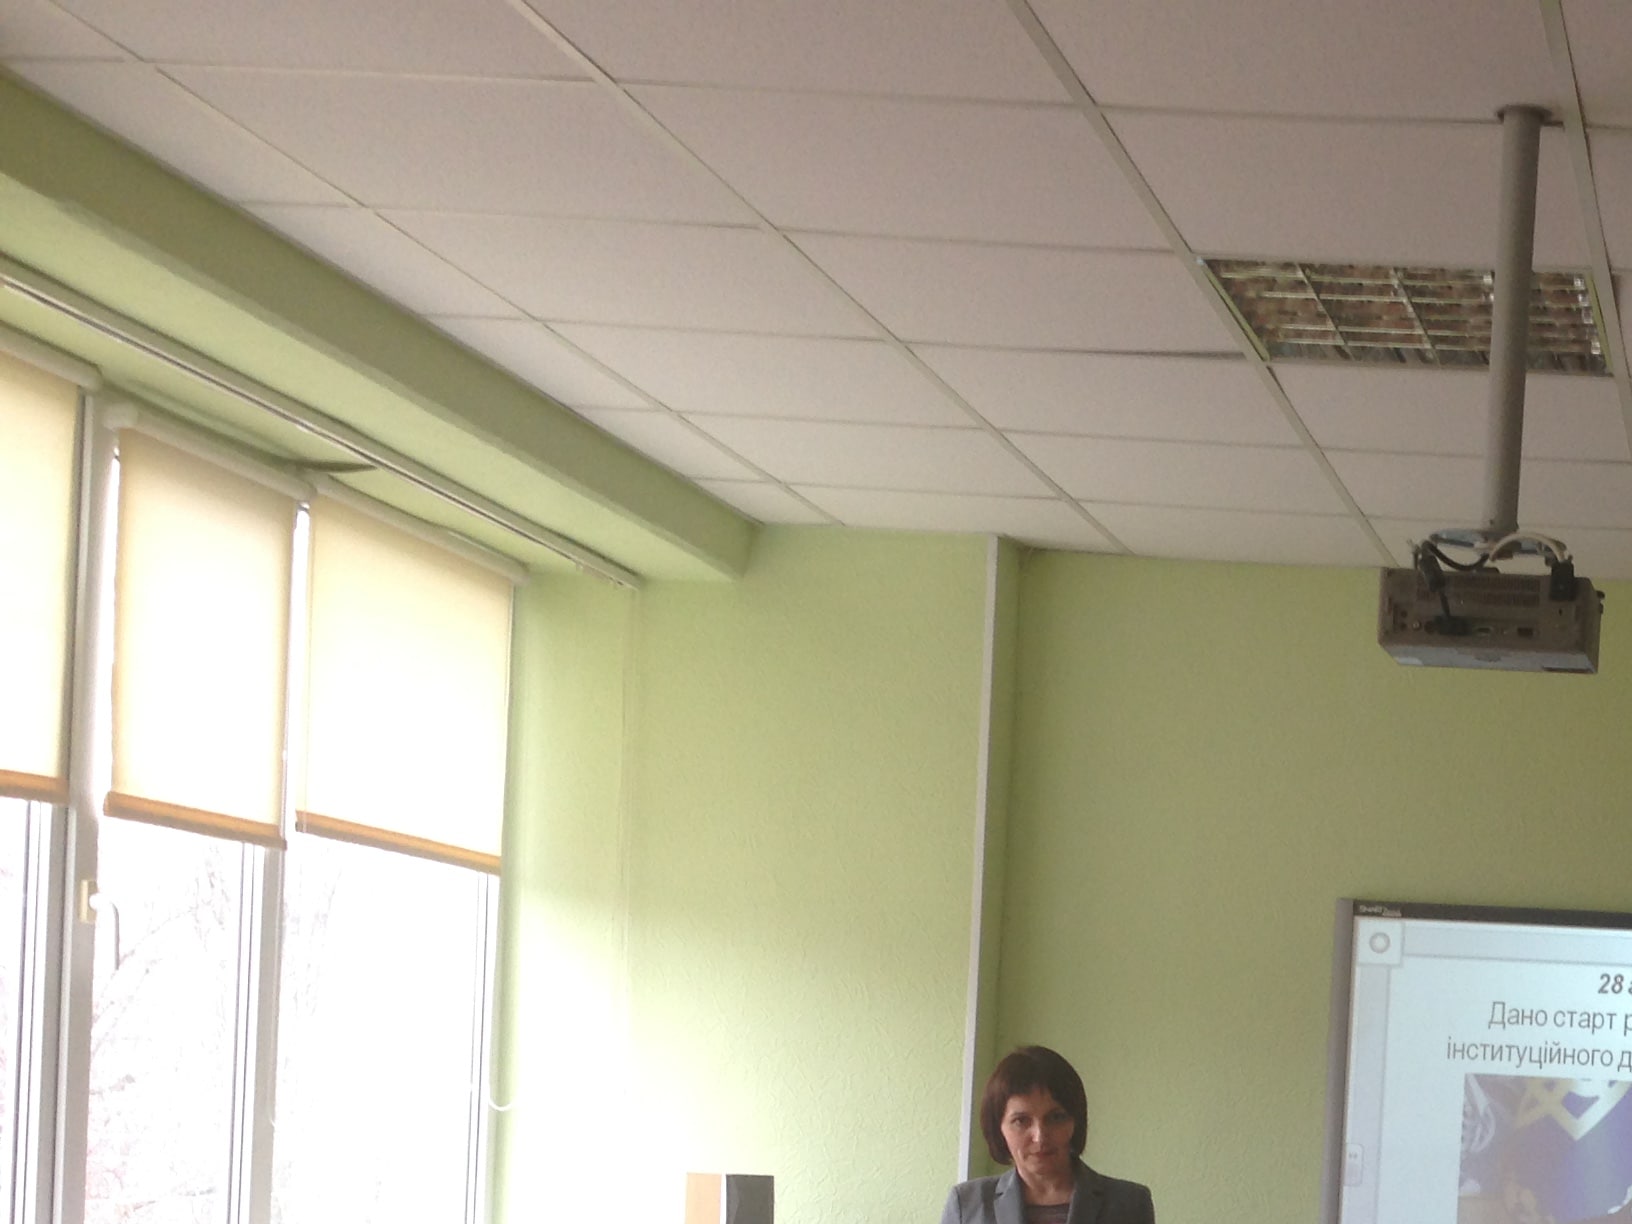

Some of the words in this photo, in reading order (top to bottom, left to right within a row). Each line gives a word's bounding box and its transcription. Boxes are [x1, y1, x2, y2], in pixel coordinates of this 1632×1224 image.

[1598, 973, 1624, 995] 28
[1488, 1001, 1548, 1029] Дано
[1553, 1010, 1617, 1034] старт
[1446, 1036, 1614, 1069] інституційного
